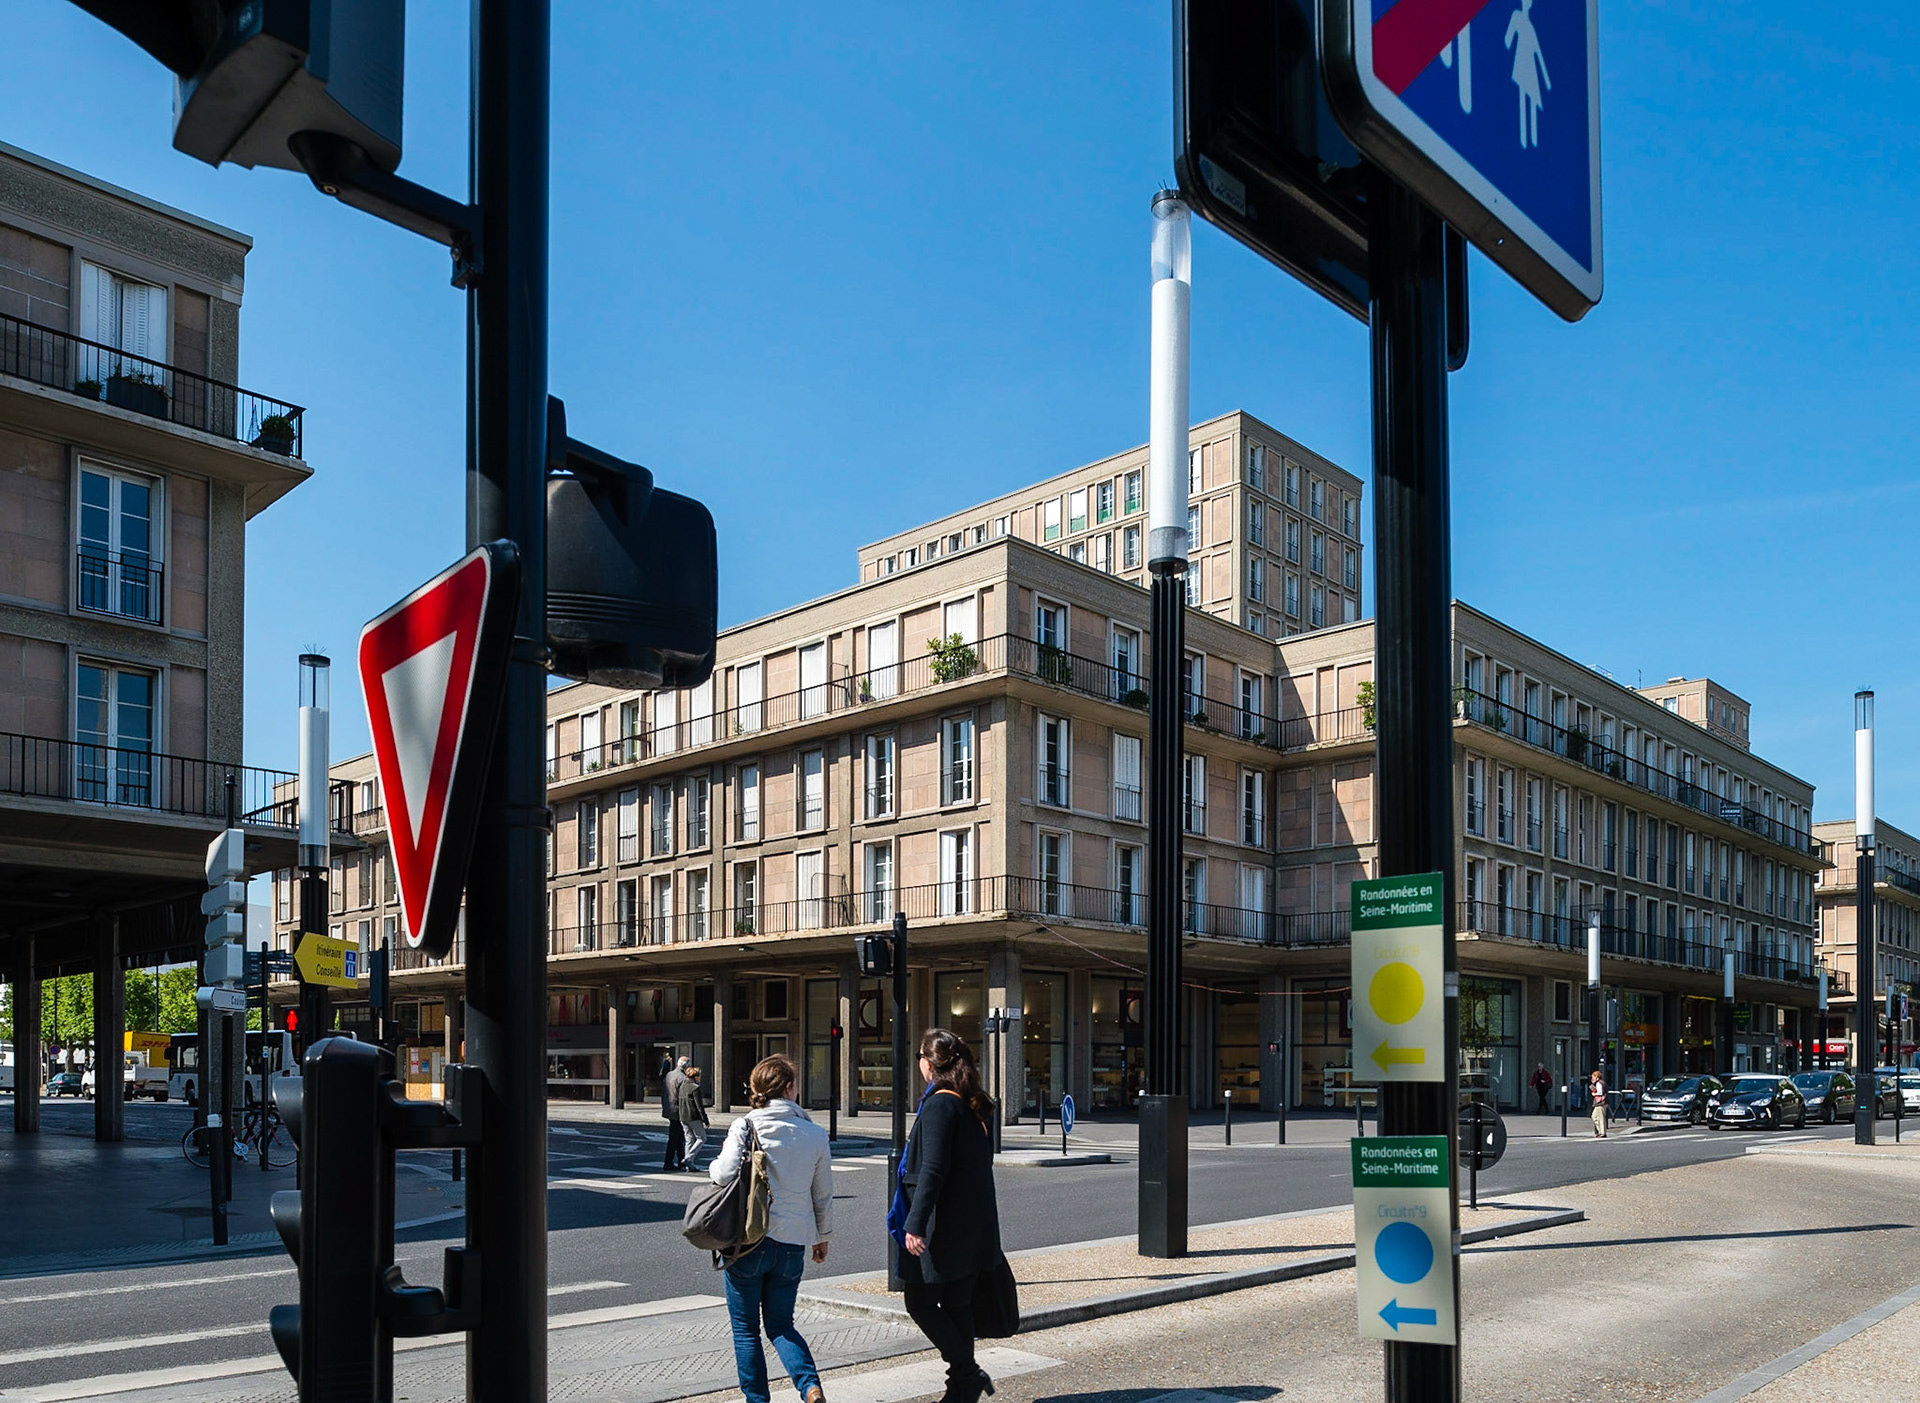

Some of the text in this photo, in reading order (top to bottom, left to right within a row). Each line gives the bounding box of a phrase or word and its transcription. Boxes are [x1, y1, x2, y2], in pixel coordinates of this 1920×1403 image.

[1360, 885, 1433, 901] Randonnées en
[1360, 901, 1433, 918] Seine-Maritime
[316, 943, 342, 959] Itinéraire
[316, 963, 341, 979] Conseillé
[1361, 1146, 1438, 1158] Randonnées en
[1361, 1162, 1439, 1175] Seine-Maritime
